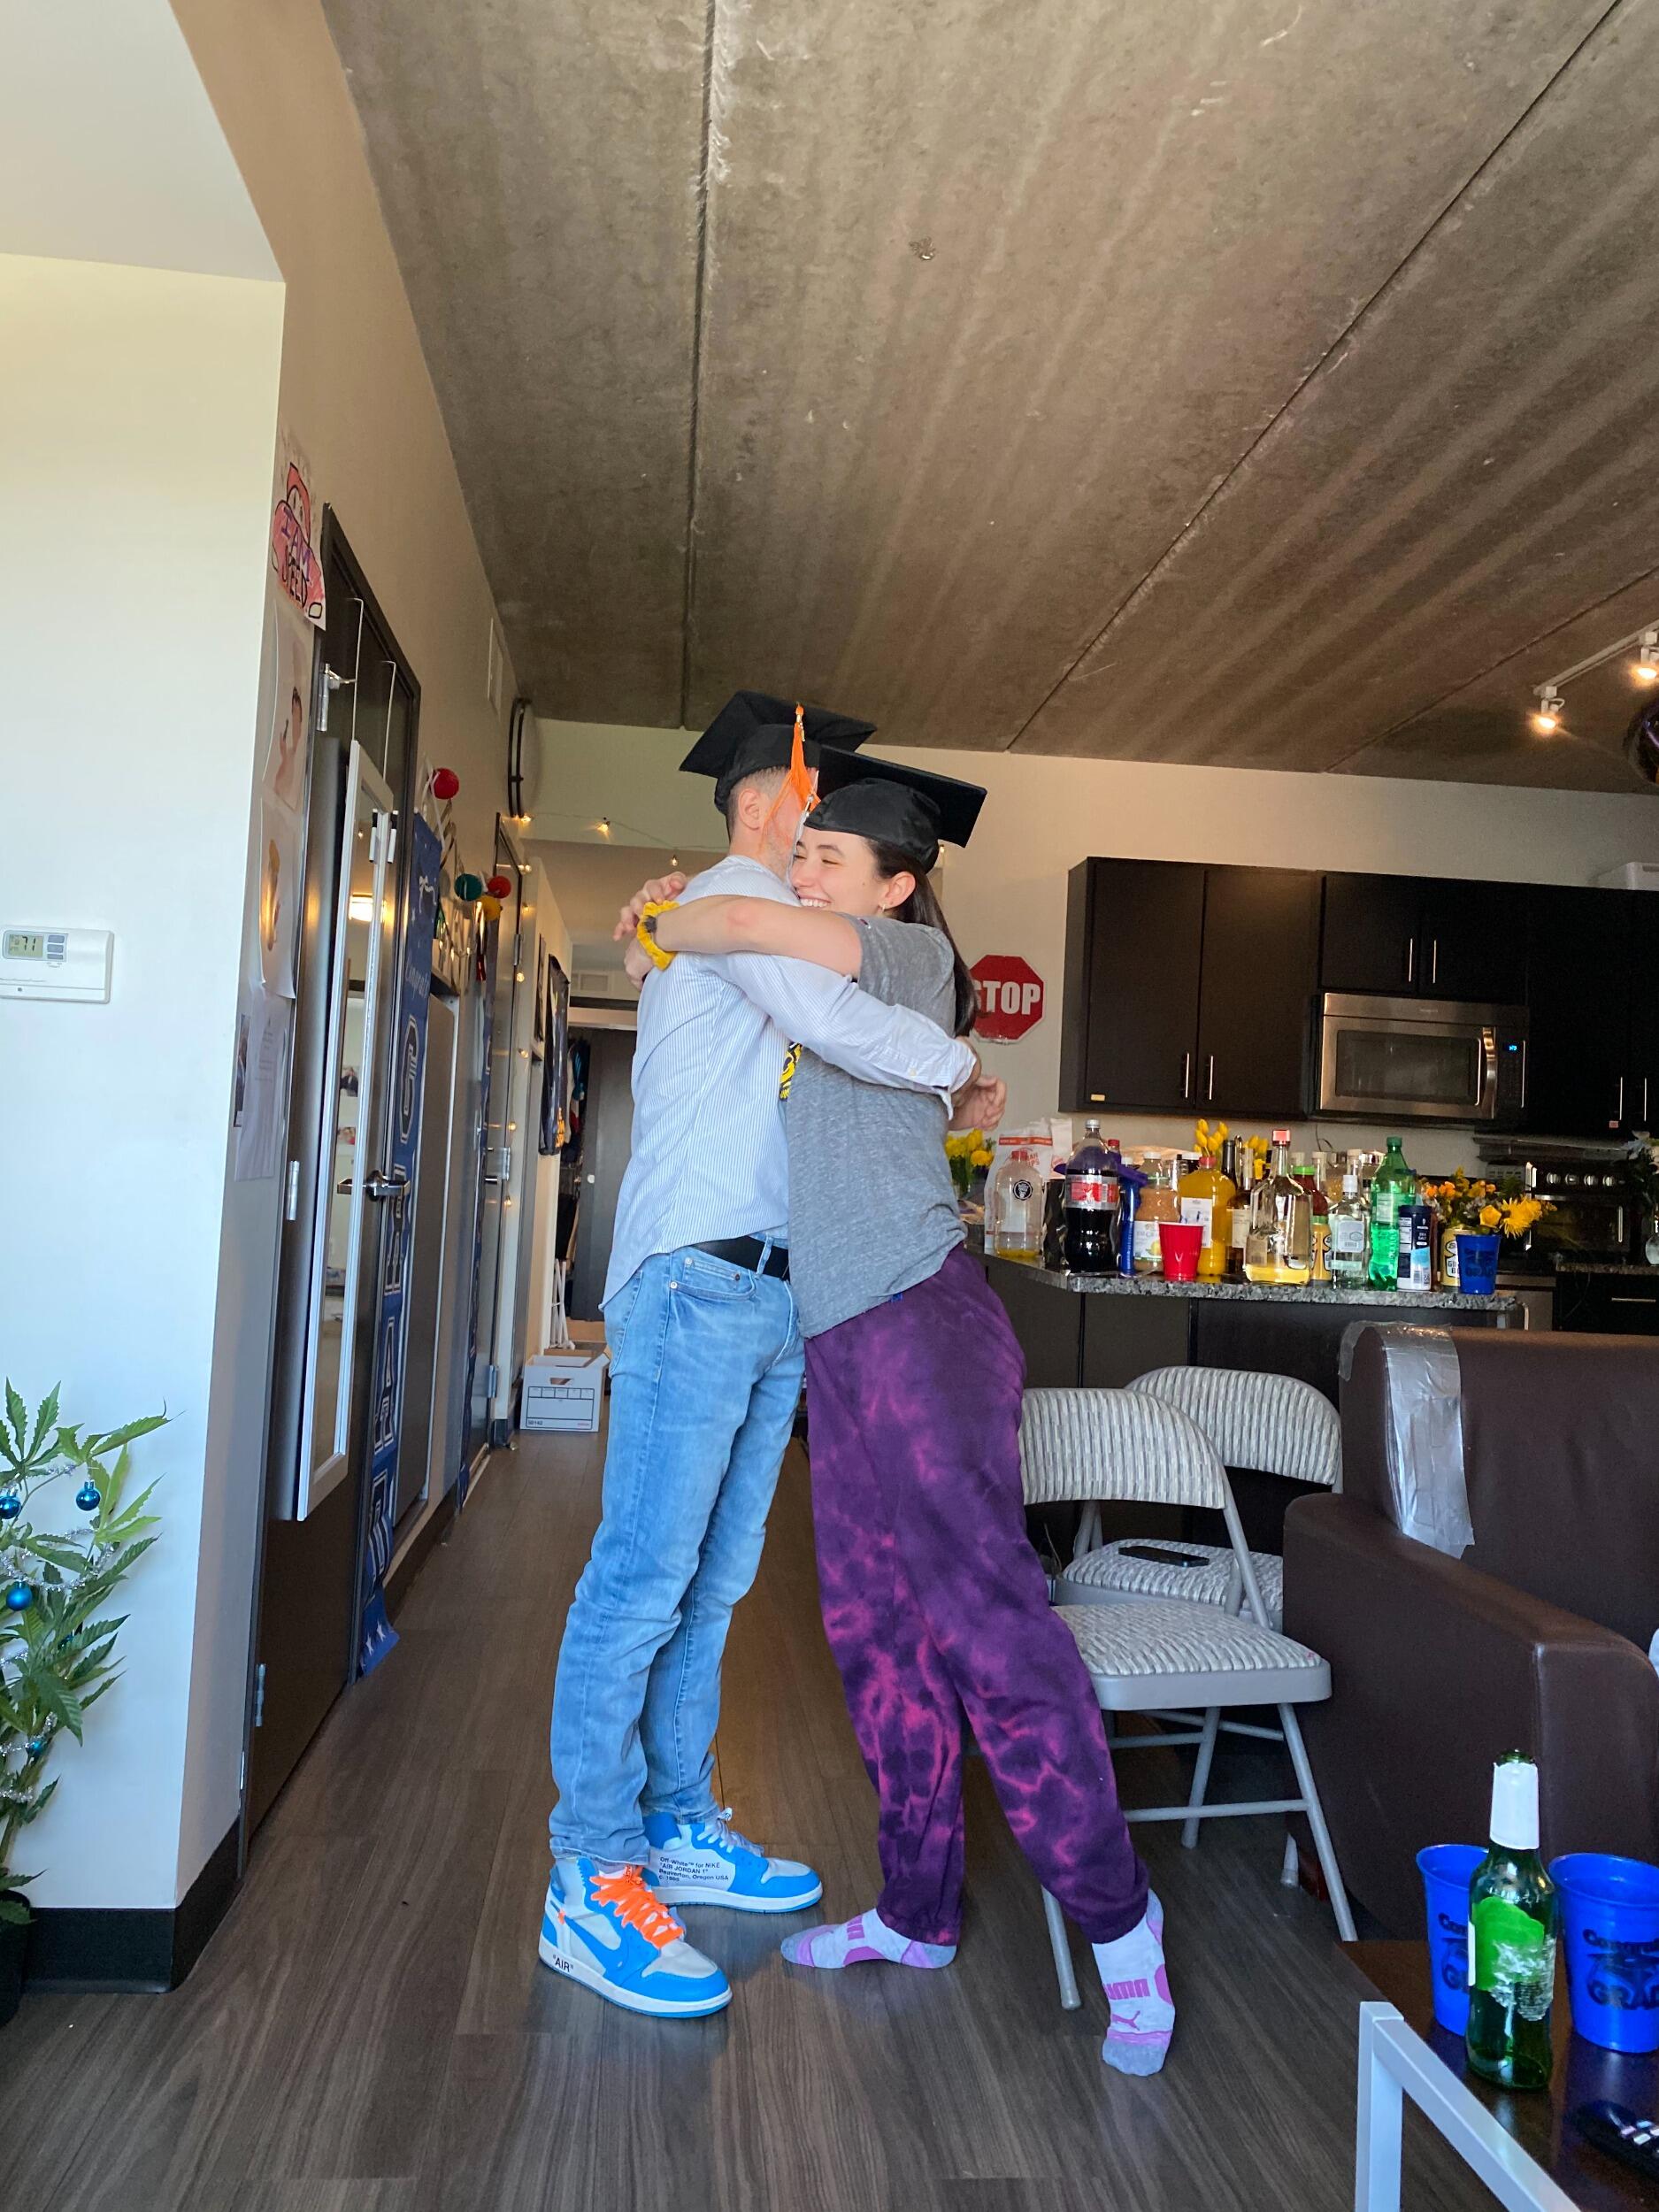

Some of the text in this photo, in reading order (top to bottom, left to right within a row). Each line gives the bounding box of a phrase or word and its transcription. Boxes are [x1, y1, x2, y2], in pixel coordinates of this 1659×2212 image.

[22, 935, 36, 951] 71
[674, 1865, 701, 1874] JORDAN
[1106, 1978, 1150, 2000] UMA
